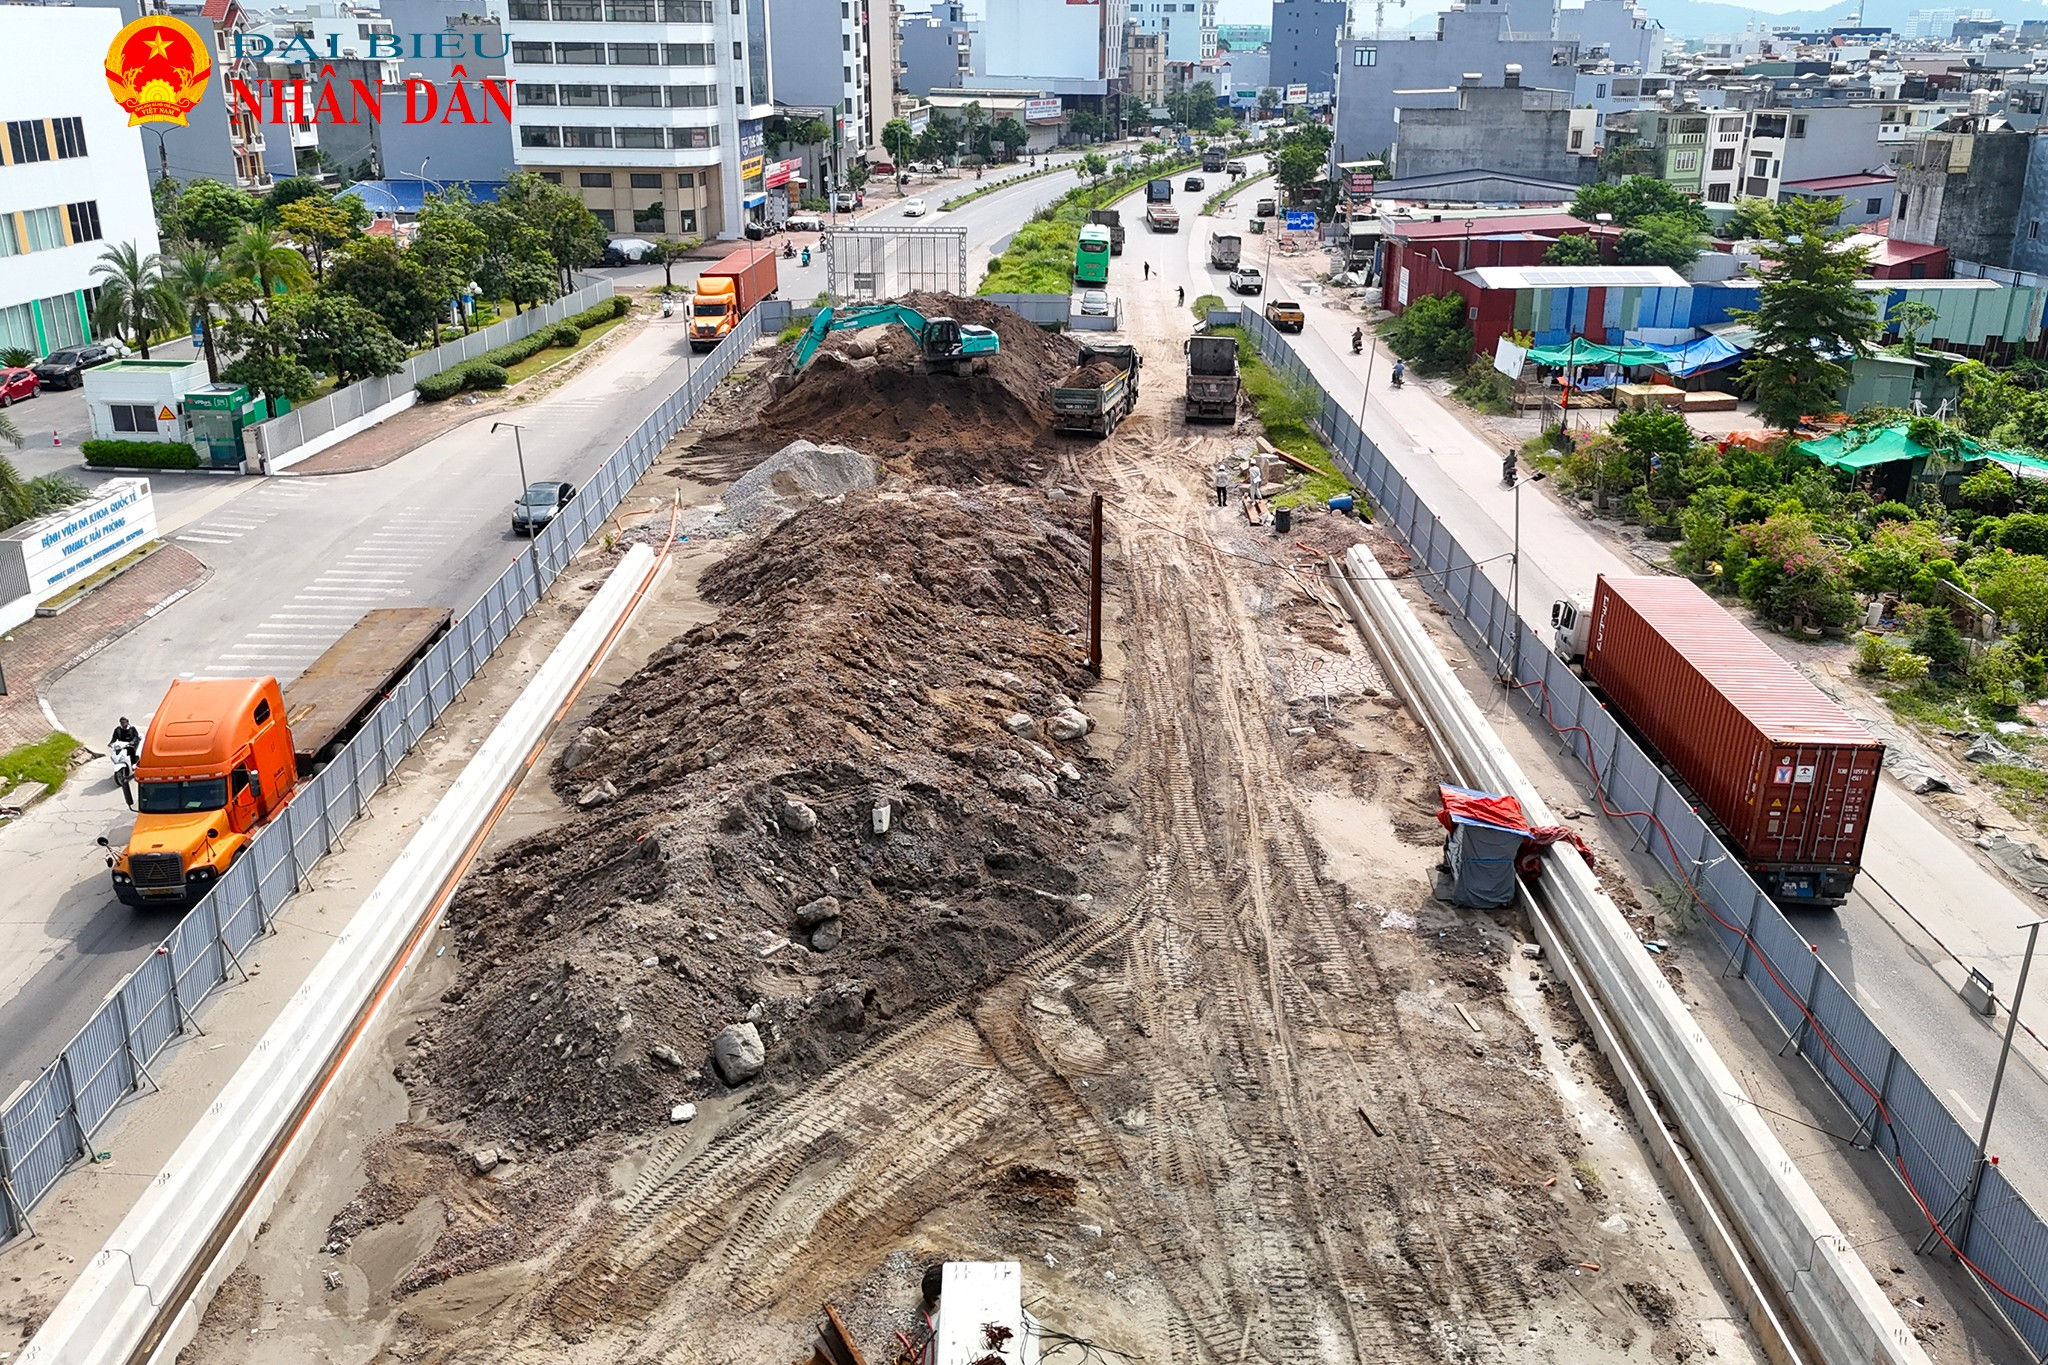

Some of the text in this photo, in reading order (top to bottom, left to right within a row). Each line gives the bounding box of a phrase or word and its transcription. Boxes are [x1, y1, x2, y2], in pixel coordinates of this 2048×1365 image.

[41, 531, 61, 548] BỆNH
[61, 522, 78, 537] VIỆN
[89, 508, 109, 524] KHOA
[110, 495, 129, 512] QUỐC
[129, 487, 137, 502] TẾ
[62, 517, 126, 556] VINMEC HẢI PHÒNG
